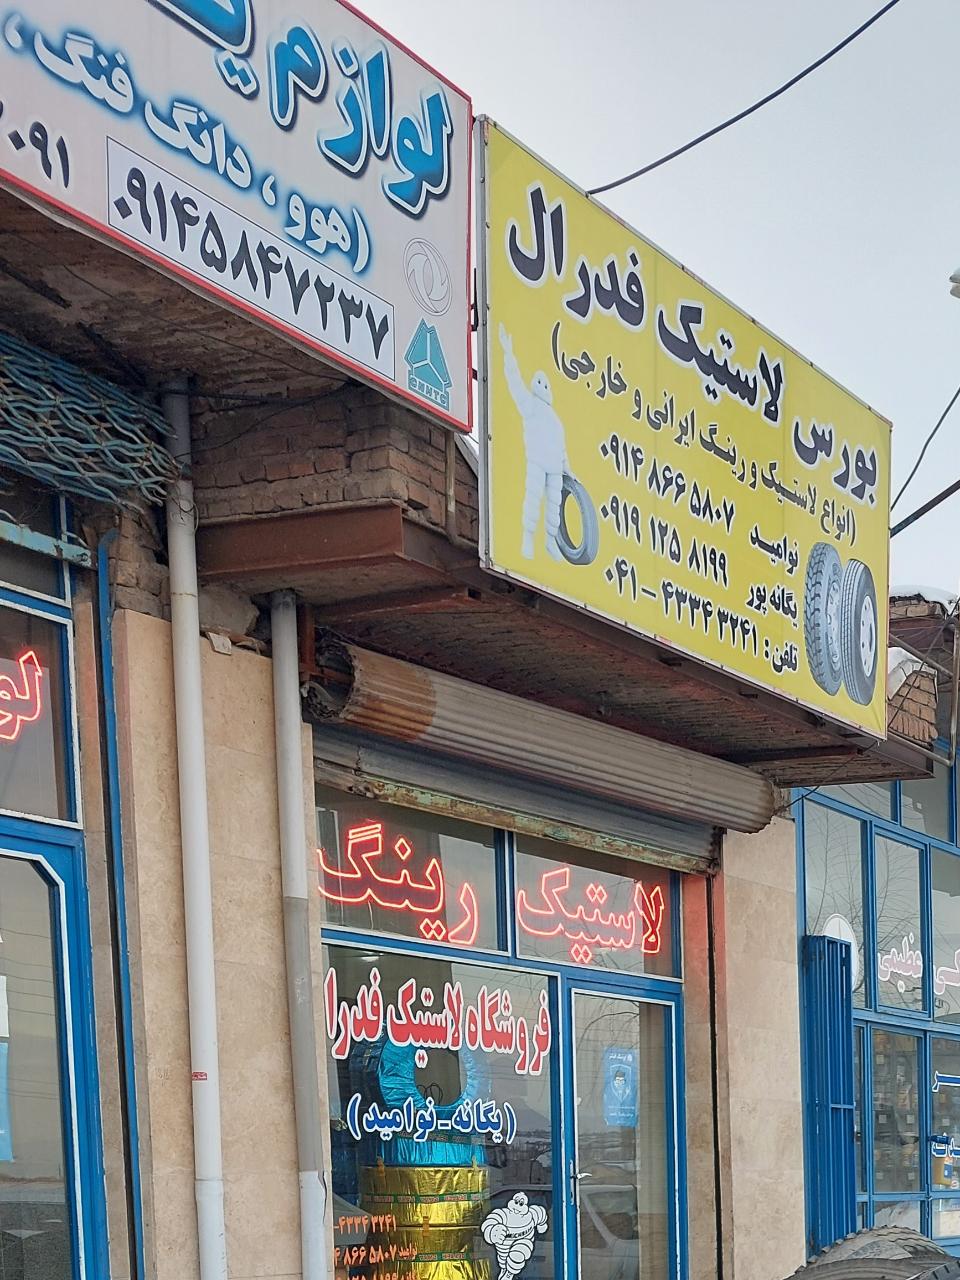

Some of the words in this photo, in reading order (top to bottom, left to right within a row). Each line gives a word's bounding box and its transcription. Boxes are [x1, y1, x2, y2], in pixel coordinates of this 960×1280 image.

[33, 32, 135, 113] فنگ
[144, 101, 251, 187] دانگ
[268, 25, 452, 215] لوازم
[113, 167, 389, 360] ۰۹۱۴۵۸۴۷۲۳۷
[509, 187, 644, 327] فدرال
[631, 388, 642, 420] و
[658, 304, 783, 421] لاستیک
[645, 389, 695, 447] ایرانی
[699, 423, 746, 483] رینگ
[748, 461, 758, 489] و
[761, 460, 817, 515] لاستیک
[794, 421, 877, 504] بورس
[750, 524, 798, 574] نوامید
[316, 823, 479, 945] رینگ
[516, 867, 665, 965] لاستیک
[878, 932, 923, 993] عظیمی
[387, 978, 464, 1069] لاستیک
[466, 985, 552, 1076] فروشگاه
